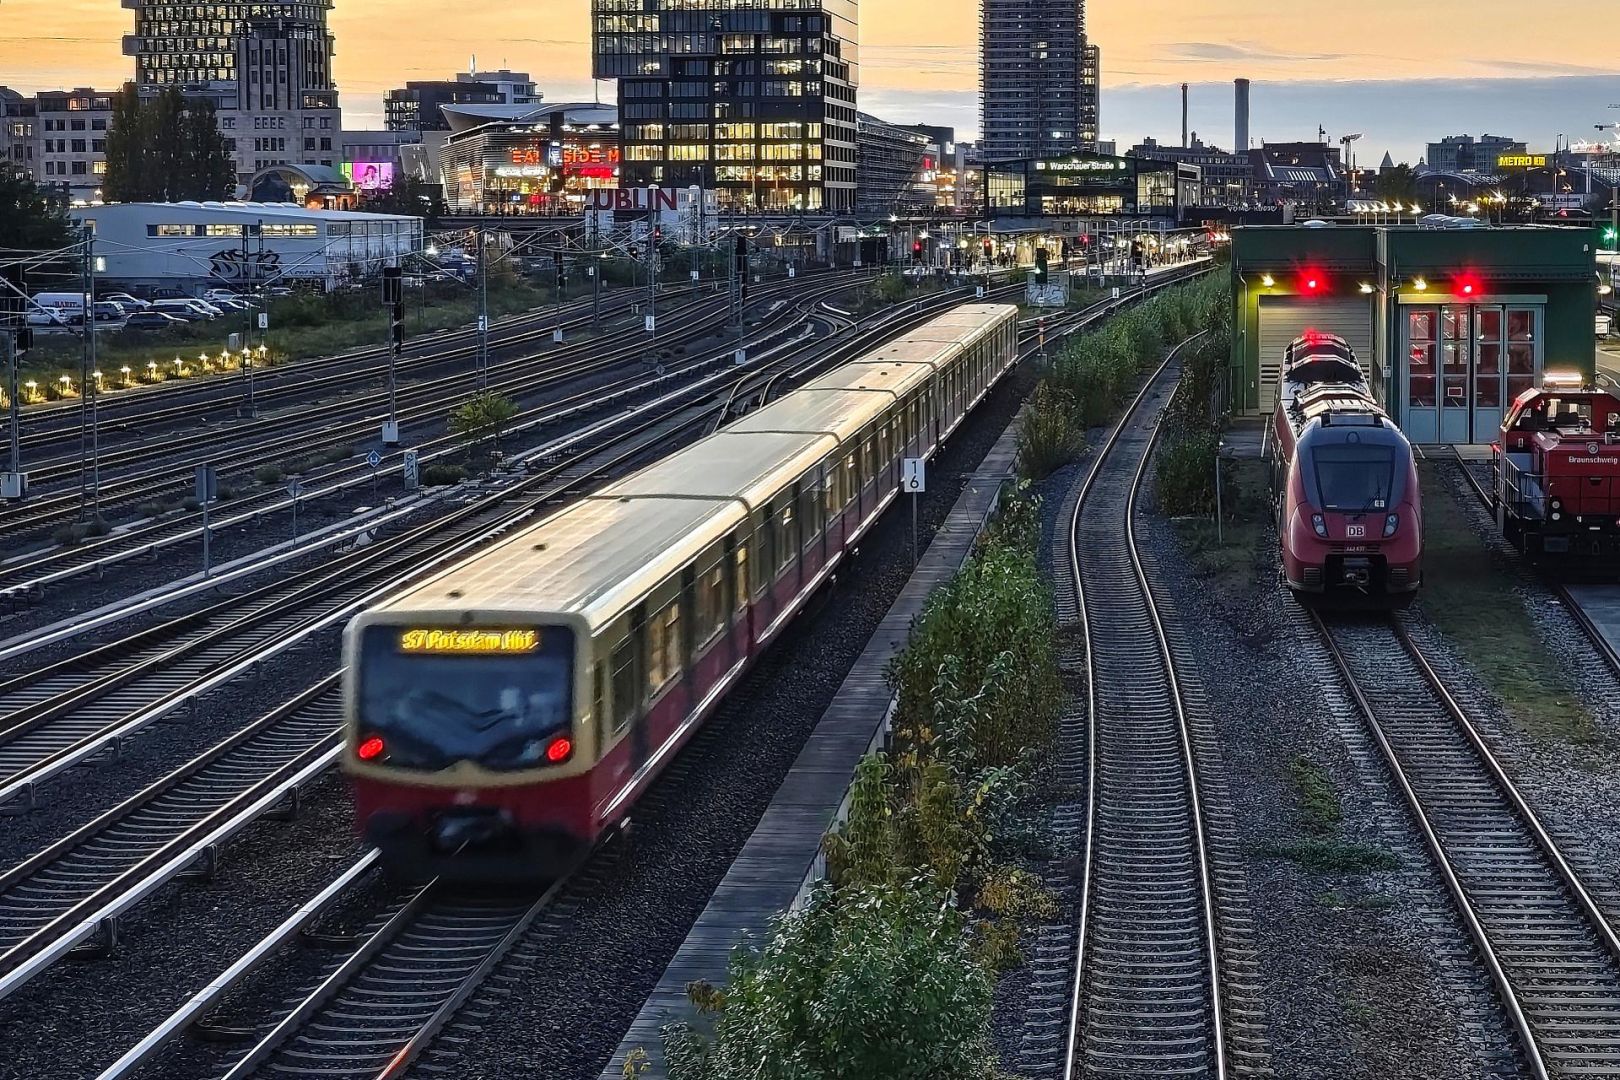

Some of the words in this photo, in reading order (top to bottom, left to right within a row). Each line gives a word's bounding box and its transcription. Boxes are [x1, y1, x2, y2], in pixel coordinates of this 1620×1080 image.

[1050, 162, 1090, 170] Warschauer
[1091, 162, 1114, 170] Straße
[1498, 156, 1532, 166] METRO
[1568, 455, 1618, 465] Braunschweig
[910, 475, 919, 489] 6
[1348, 526, 1364, 536] DB
[402, 630, 428, 649] S7
[426, 630, 501, 649] Potsdam
